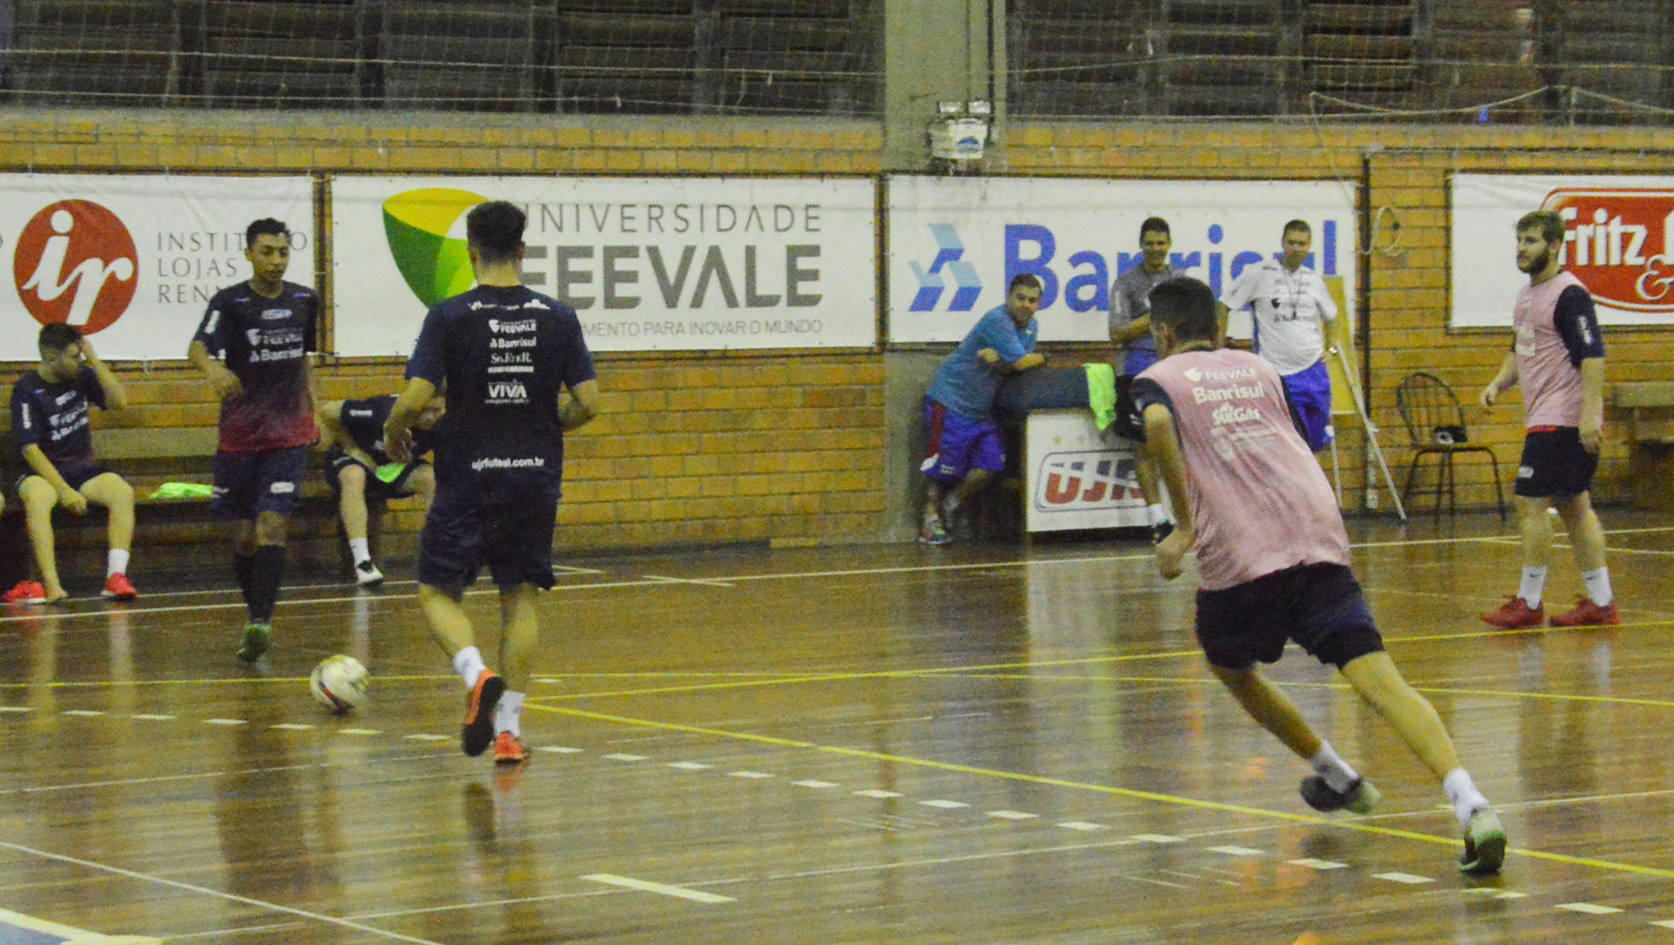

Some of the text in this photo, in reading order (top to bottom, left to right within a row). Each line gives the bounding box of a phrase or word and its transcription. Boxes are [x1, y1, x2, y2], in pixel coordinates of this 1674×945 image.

[157, 231, 308, 251] INSTITO
[158, 257, 238, 280] LOJAS
[1004, 220, 1337, 313] Baril
[643, 320, 684, 335] PARA
[689, 318, 746, 335] INOVAR
[750, 319, 762, 334] O
[765, 318, 823, 335] MUNDO
[498, 336, 537, 348] Banrisul
[488, 384, 528, 398] VIVA
[1192, 380, 1265, 405] Banrisul
